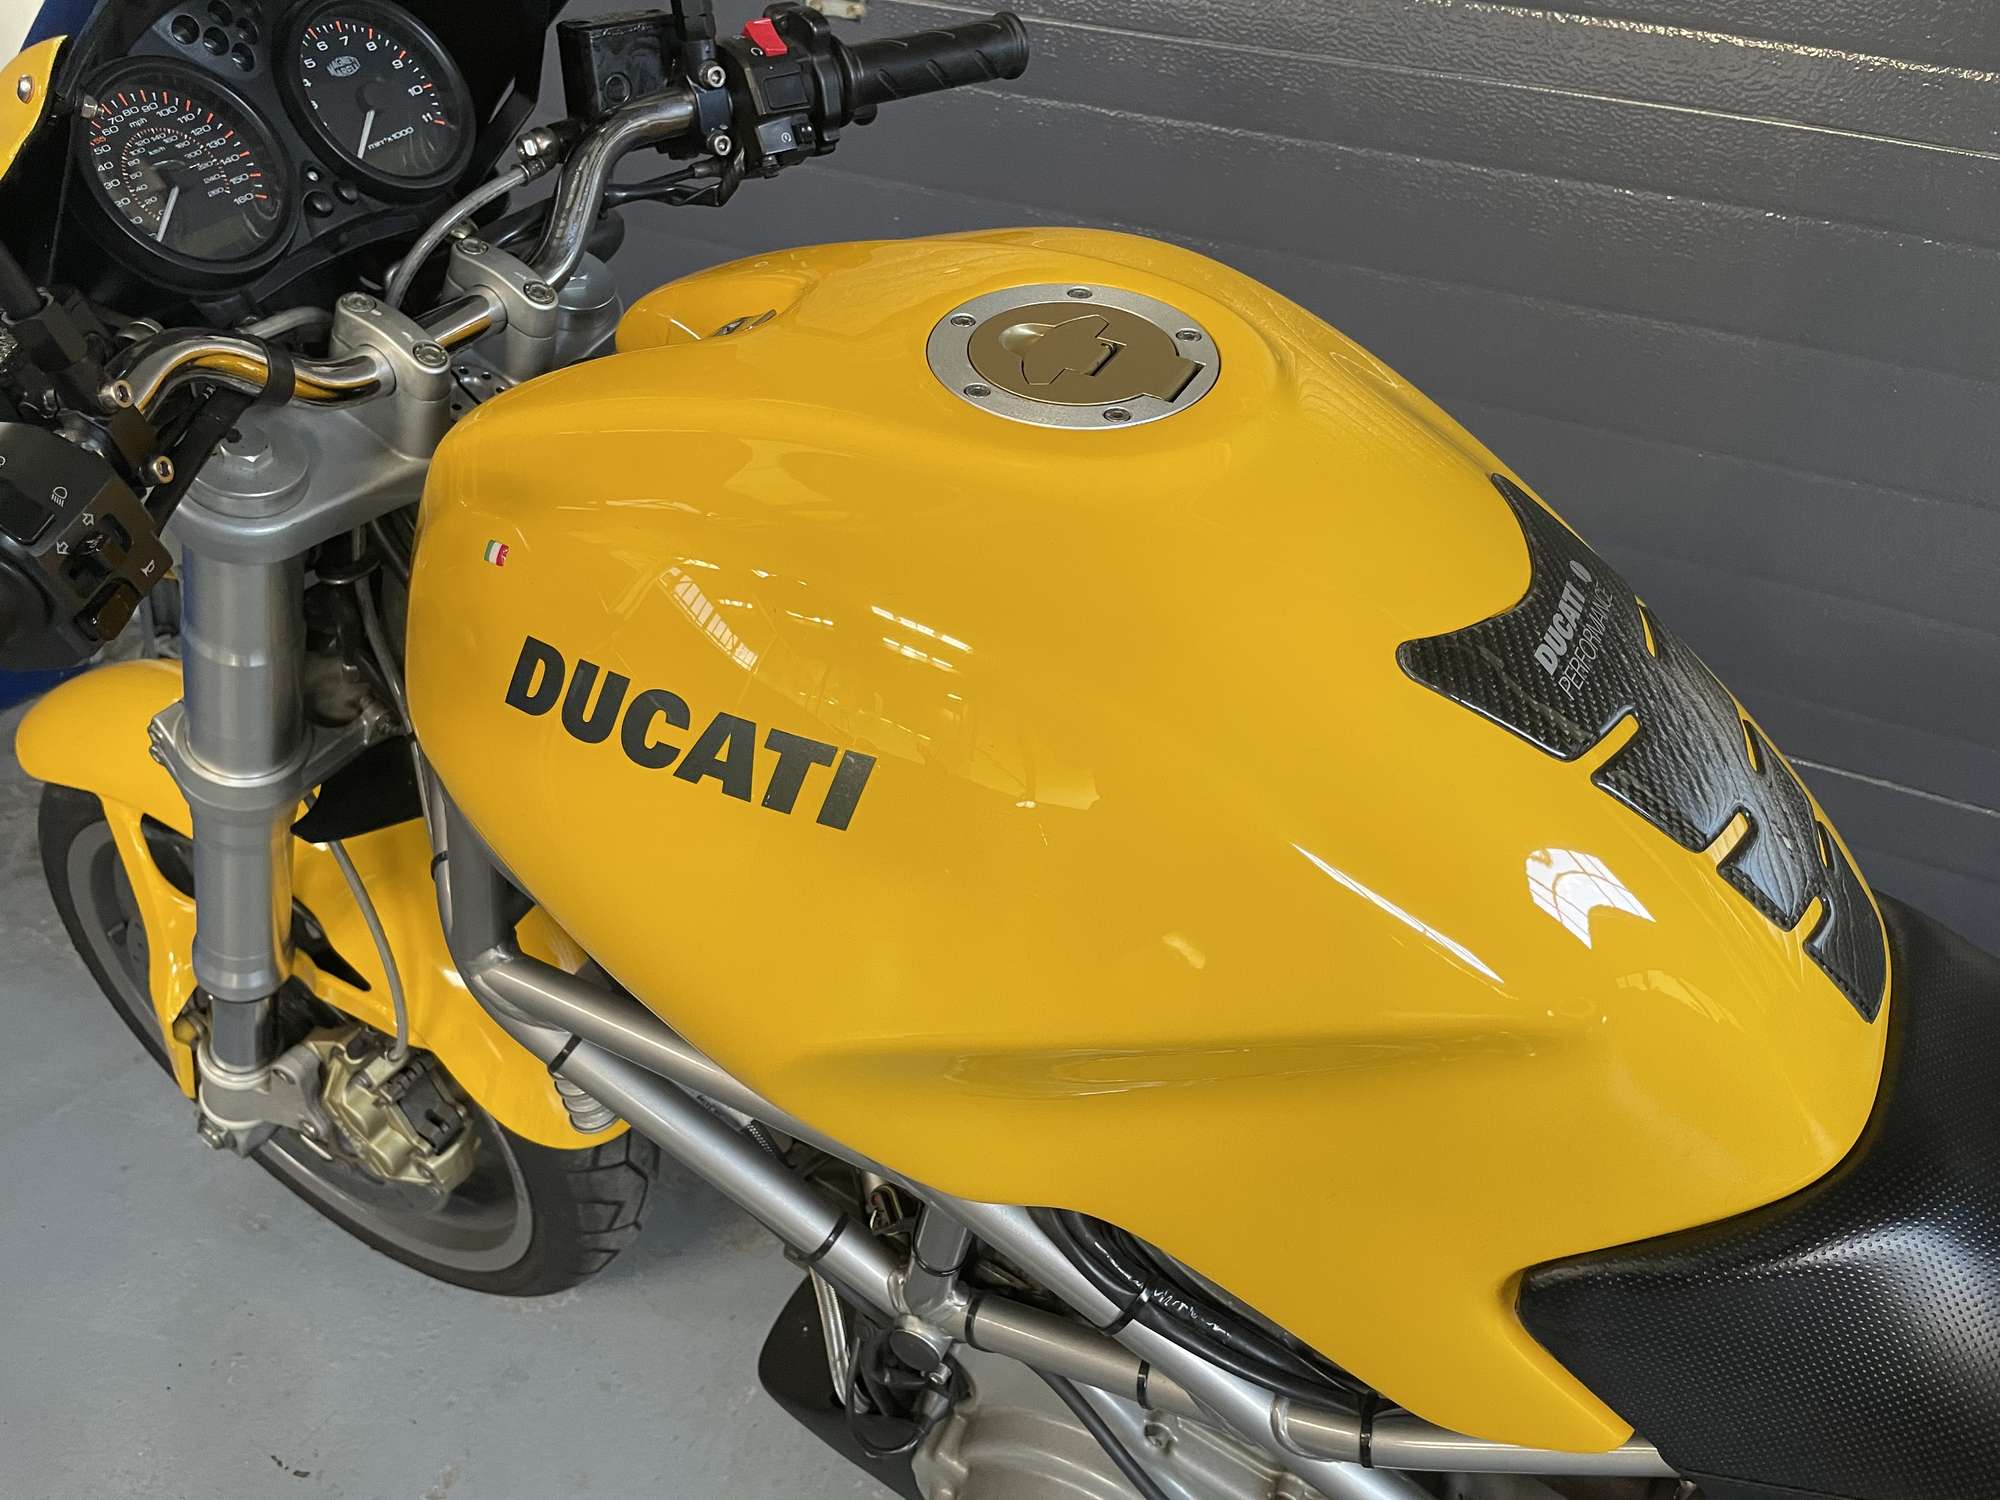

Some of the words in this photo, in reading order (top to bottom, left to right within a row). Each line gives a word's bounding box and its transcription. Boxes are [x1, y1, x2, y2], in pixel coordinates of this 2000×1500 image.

[316, 41, 328, 51] 6
[339, 35, 349, 46] 7
[366, 41, 377, 51] 8
[304, 58, 316, 68] 5
[392, 59, 404, 70] 9
[408, 84, 424, 97] 10
[122, 106, 139, 117] 80
[142, 102, 158, 113] 90
[156, 105, 178, 118] 100
[107, 114, 125, 125] 70
[177, 113, 196, 124] 110
[422, 112, 433, 123] 11
[102, 126, 119, 137] 60
[94, 144, 111, 155] 50
[98, 161, 114, 172] 40
[103, 178, 121, 190] 30
[114, 197, 132, 208] 20
[1534, 580, 1586, 676] DUCATI
[1557, 579, 1614, 701] PERFORMANCE
[505, 635, 877, 831] DUCATI
